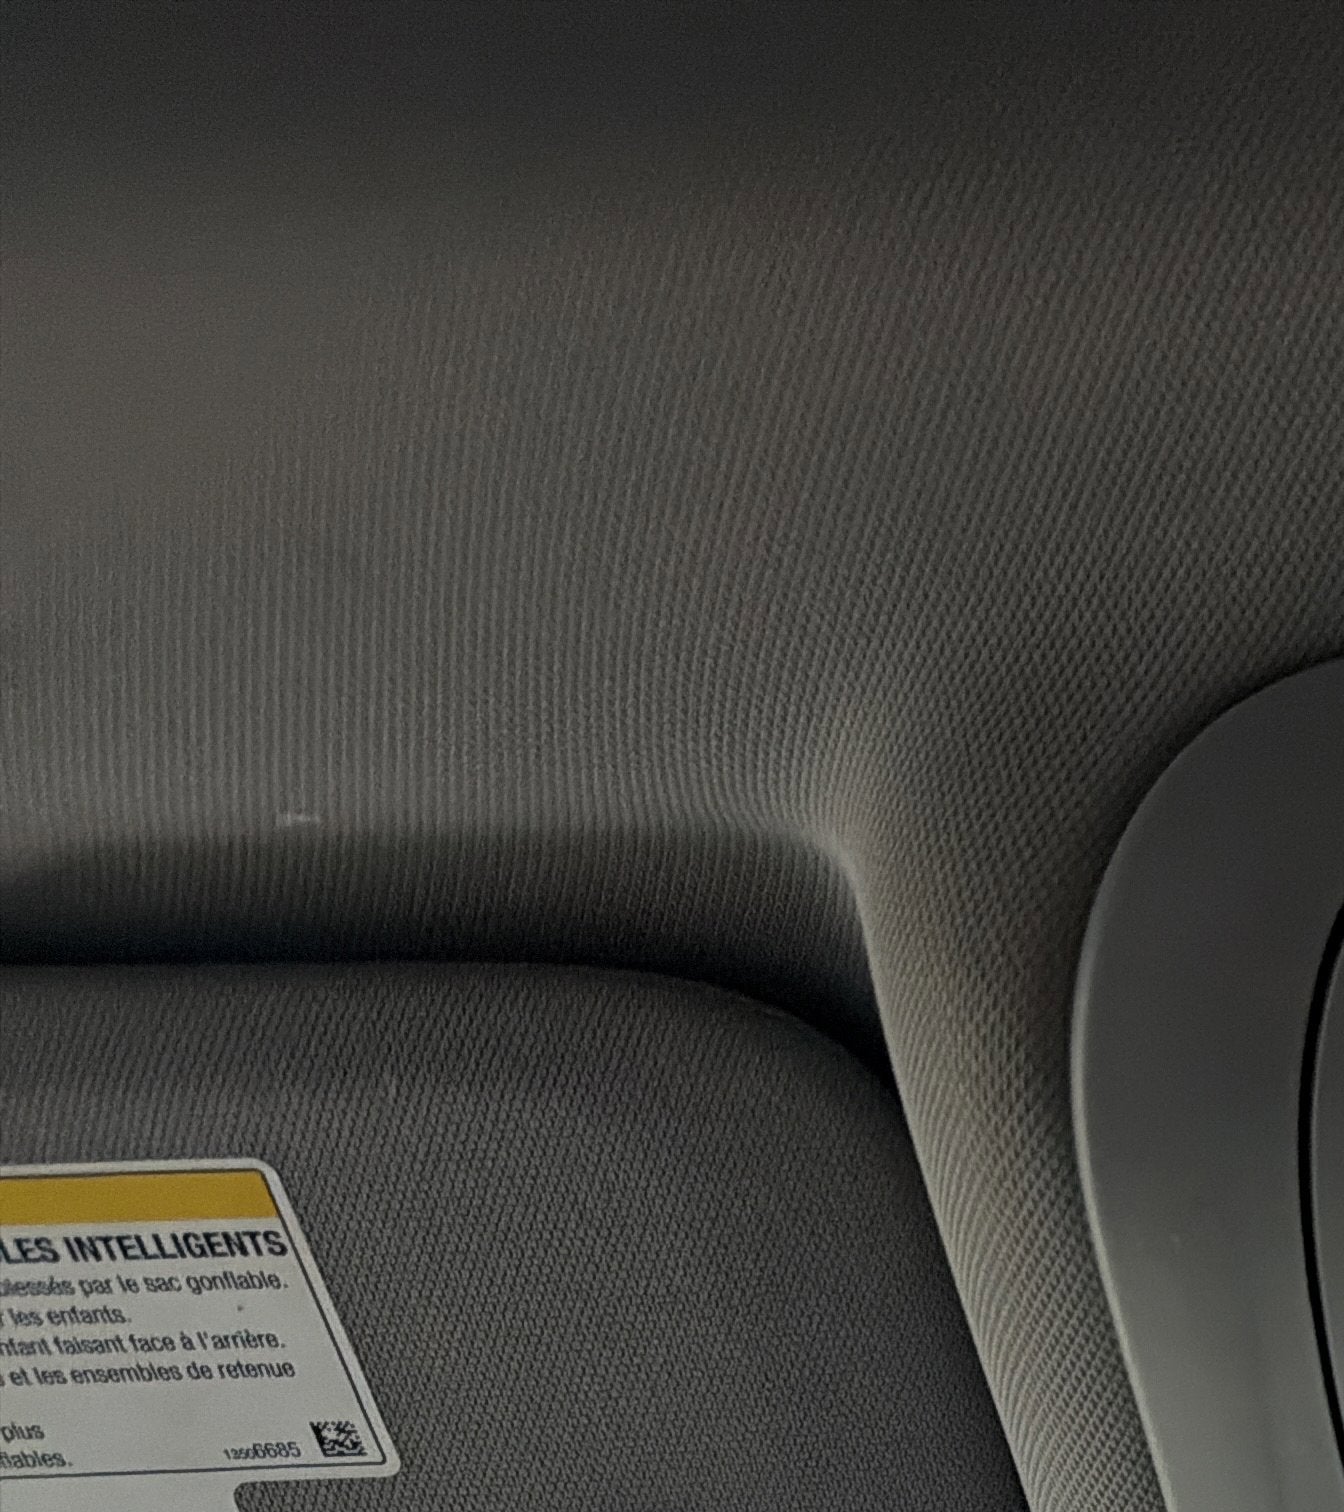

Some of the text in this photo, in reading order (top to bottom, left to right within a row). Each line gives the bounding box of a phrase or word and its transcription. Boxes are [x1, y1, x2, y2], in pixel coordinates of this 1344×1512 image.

[0, 1230, 288, 1264] LES INTELLIGENTS
[79, 1279, 113, 1298] par
[116, 1273, 140, 1293] le
[143, 1276, 182, 1292] sac
[185, 1270, 288, 1295] gonflable.
[7, 1308, 44, 1327] les
[46, 1305, 132, 1326] enfants.
[53, 1336, 128, 1355] faisant
[128, 1333, 176, 1353] face
[180, 1331, 196, 1351] à
[196, 1329, 286, 1351] l'arrière.
[9, 1367, 33, 1386] et
[32, 1366, 68, 1385] les
[70, 1361, 183, 1384] ensembles
[186, 1361, 213, 1380] de
[217, 1360, 296, 1380] retenue
[0, 1421, 45, 1443] plus
